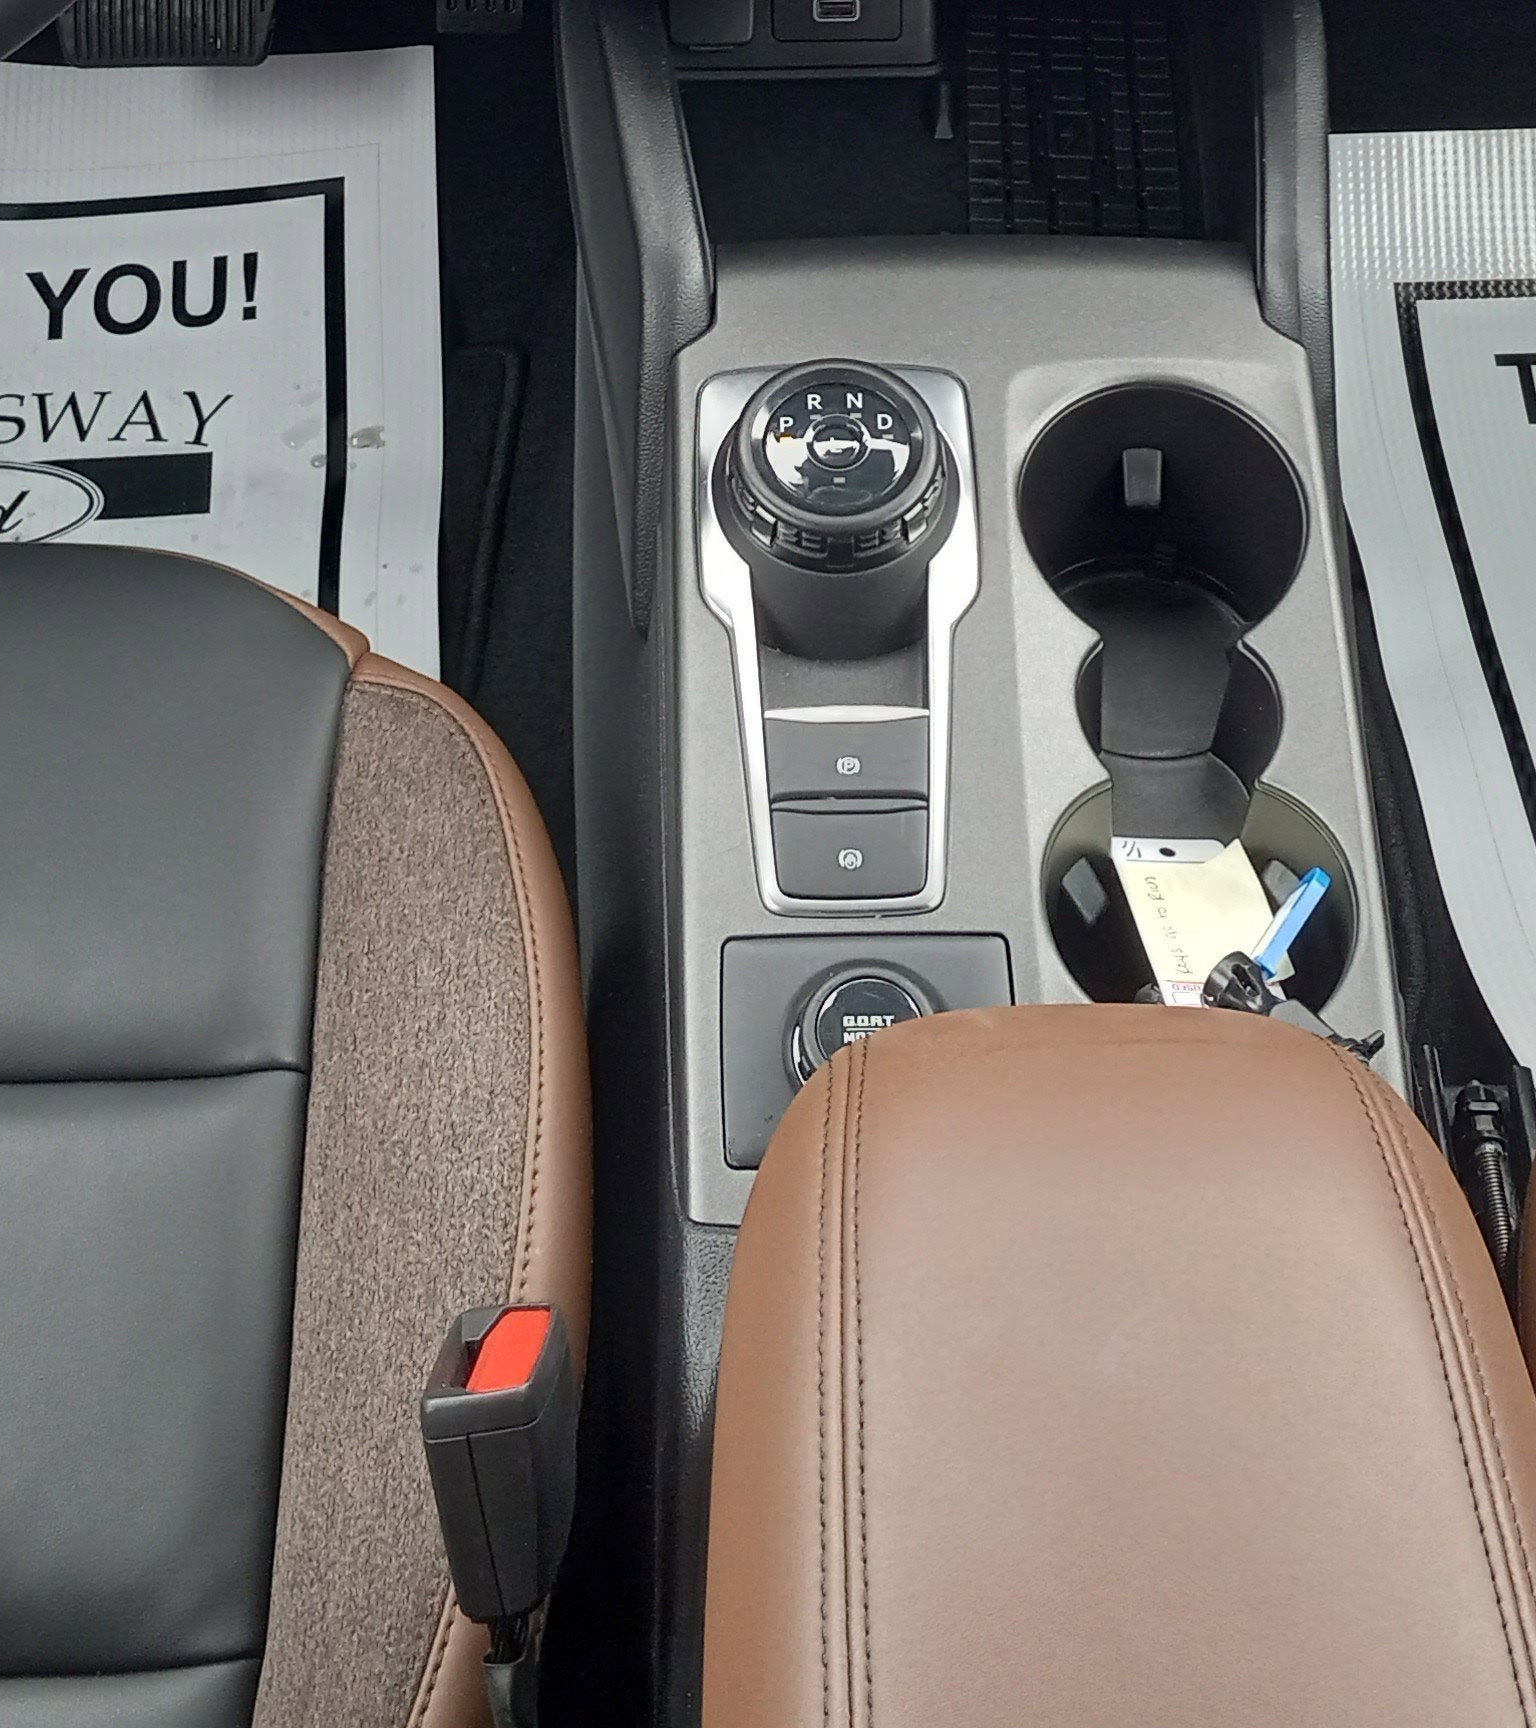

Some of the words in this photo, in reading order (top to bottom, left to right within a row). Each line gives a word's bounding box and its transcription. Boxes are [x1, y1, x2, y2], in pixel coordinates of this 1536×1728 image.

[27, 251, 260, 340] YOU!
[807, 393, 822, 411] R
[846, 392, 863, 409] N
[779, 416, 794, 432] P
[876, 414, 893, 431] D
